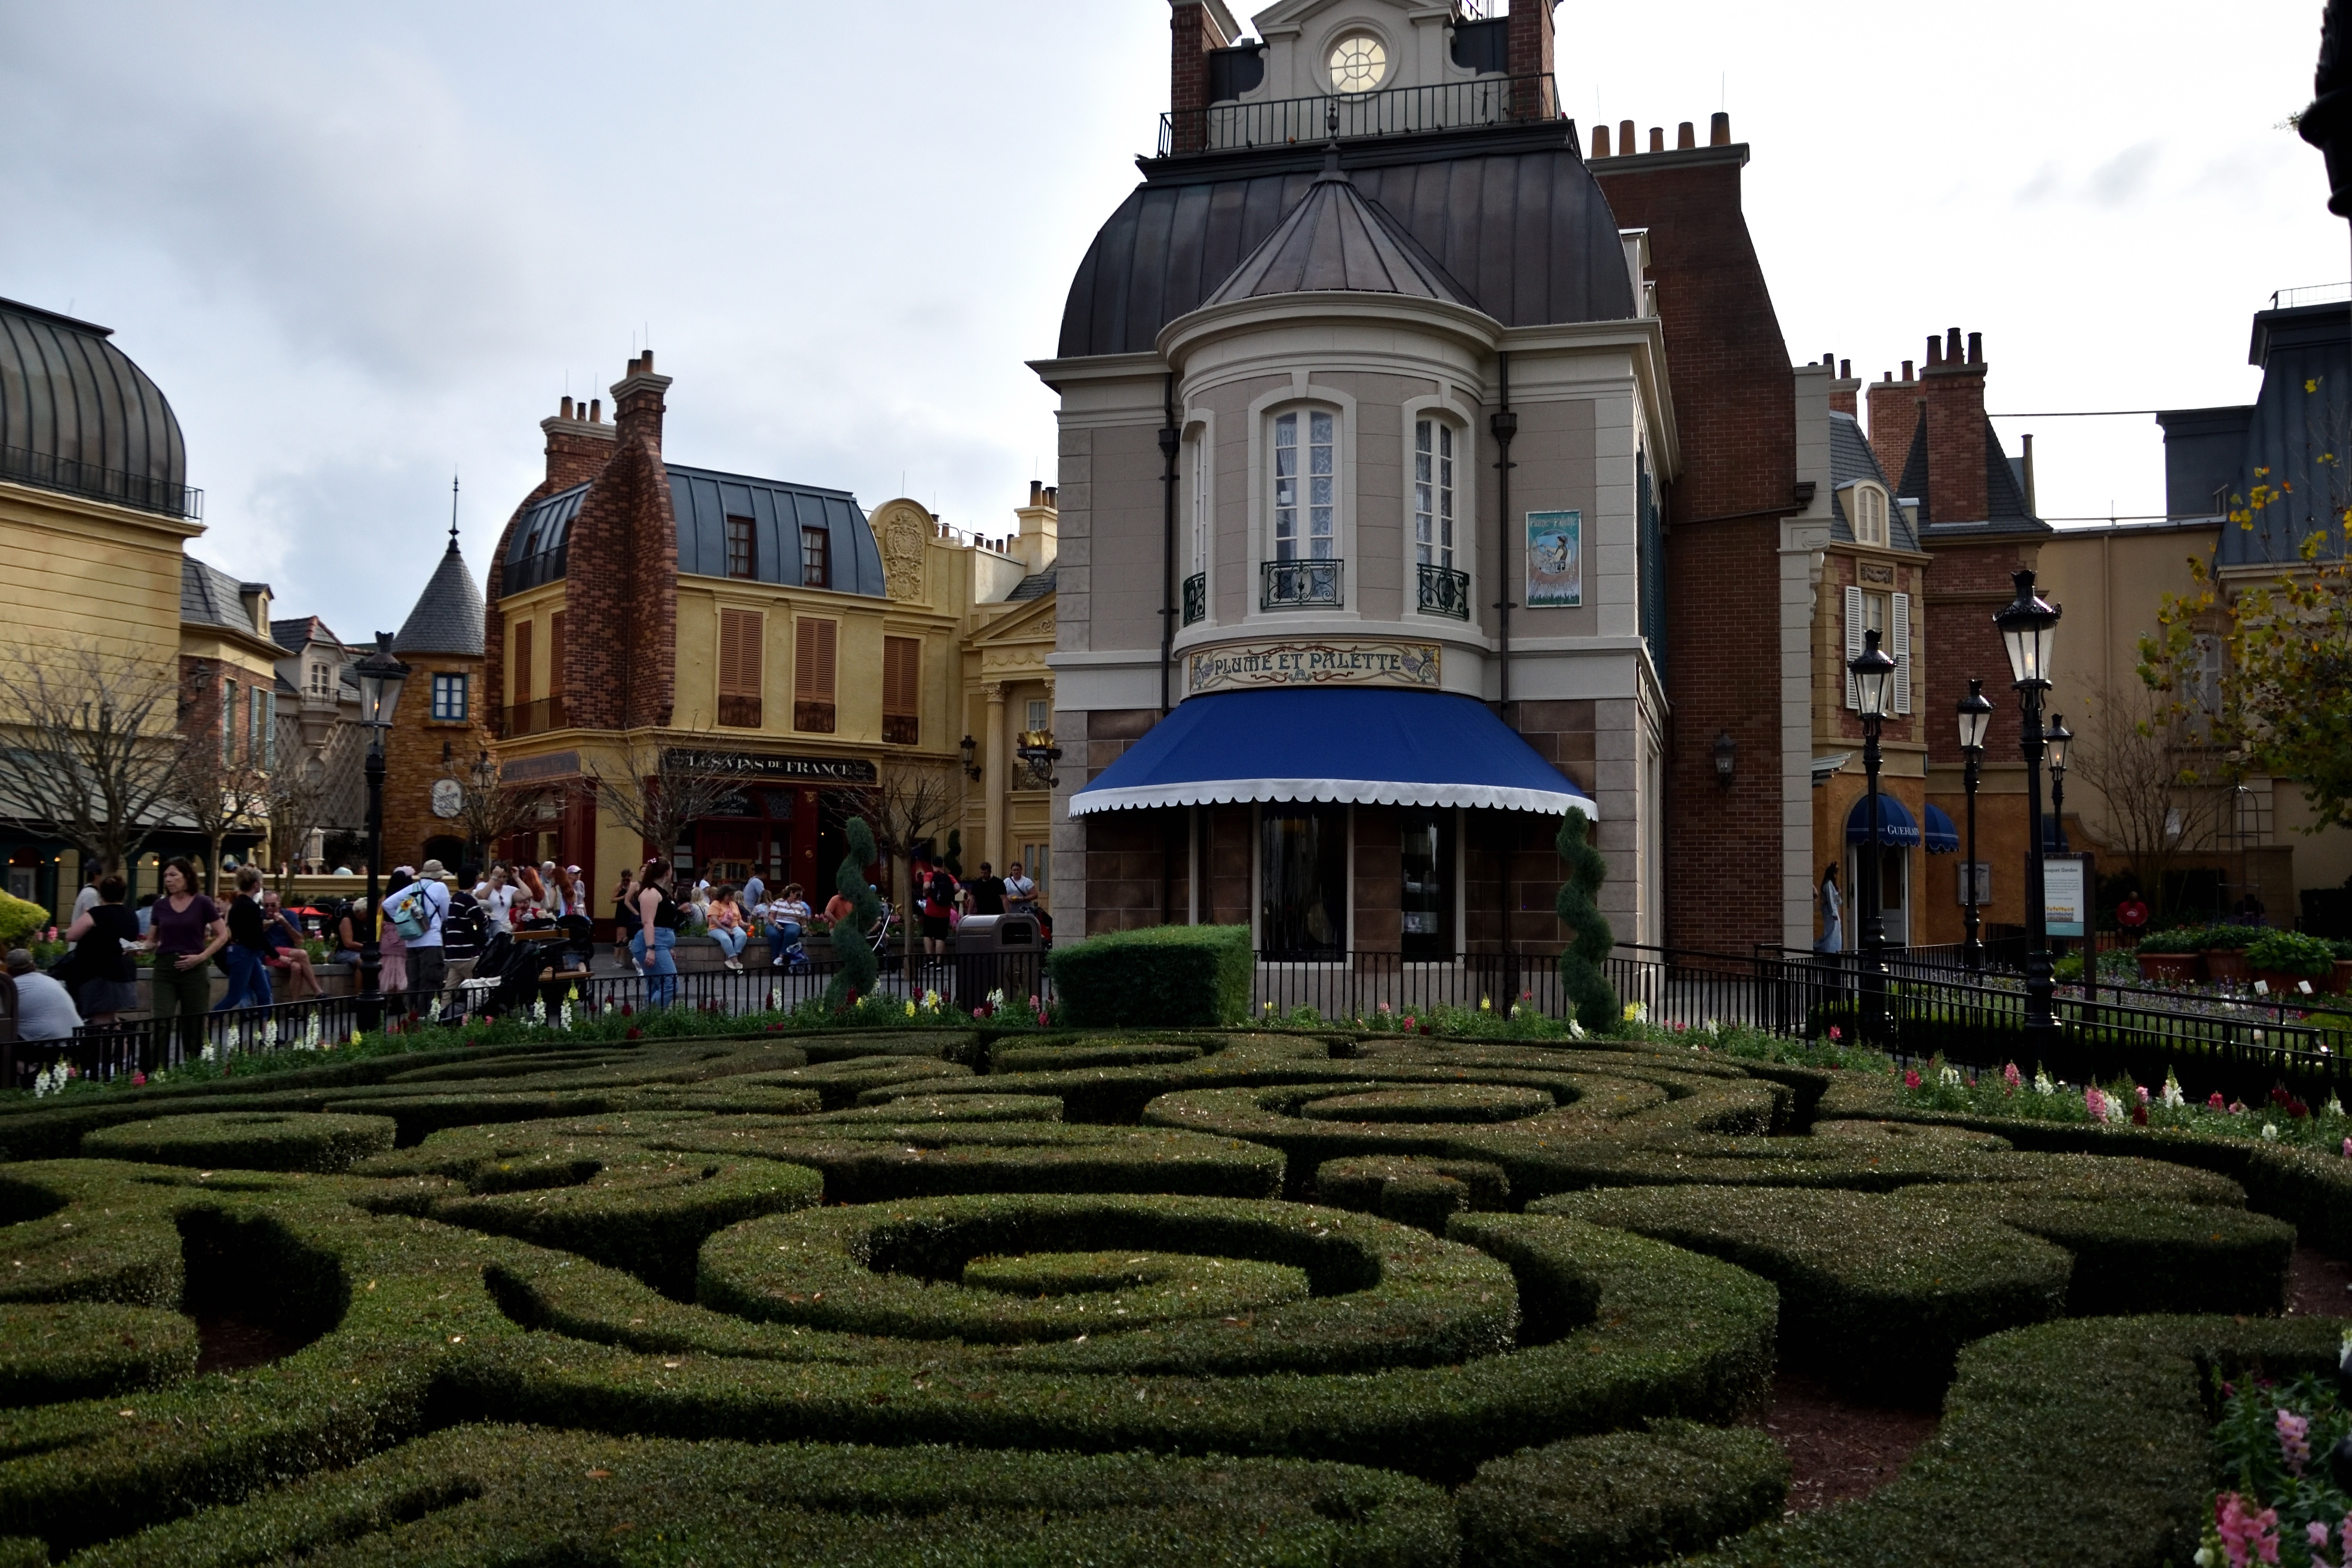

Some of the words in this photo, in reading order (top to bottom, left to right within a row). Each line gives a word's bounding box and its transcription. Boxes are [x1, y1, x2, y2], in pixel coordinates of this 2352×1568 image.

[1214, 655, 1273, 675] PLUME
[1278, 653, 1304, 670] ET
[1309, 653, 1401, 670] PALETTE
[767, 760, 783, 768] DE
[786, 761, 852, 776] FRANCE
